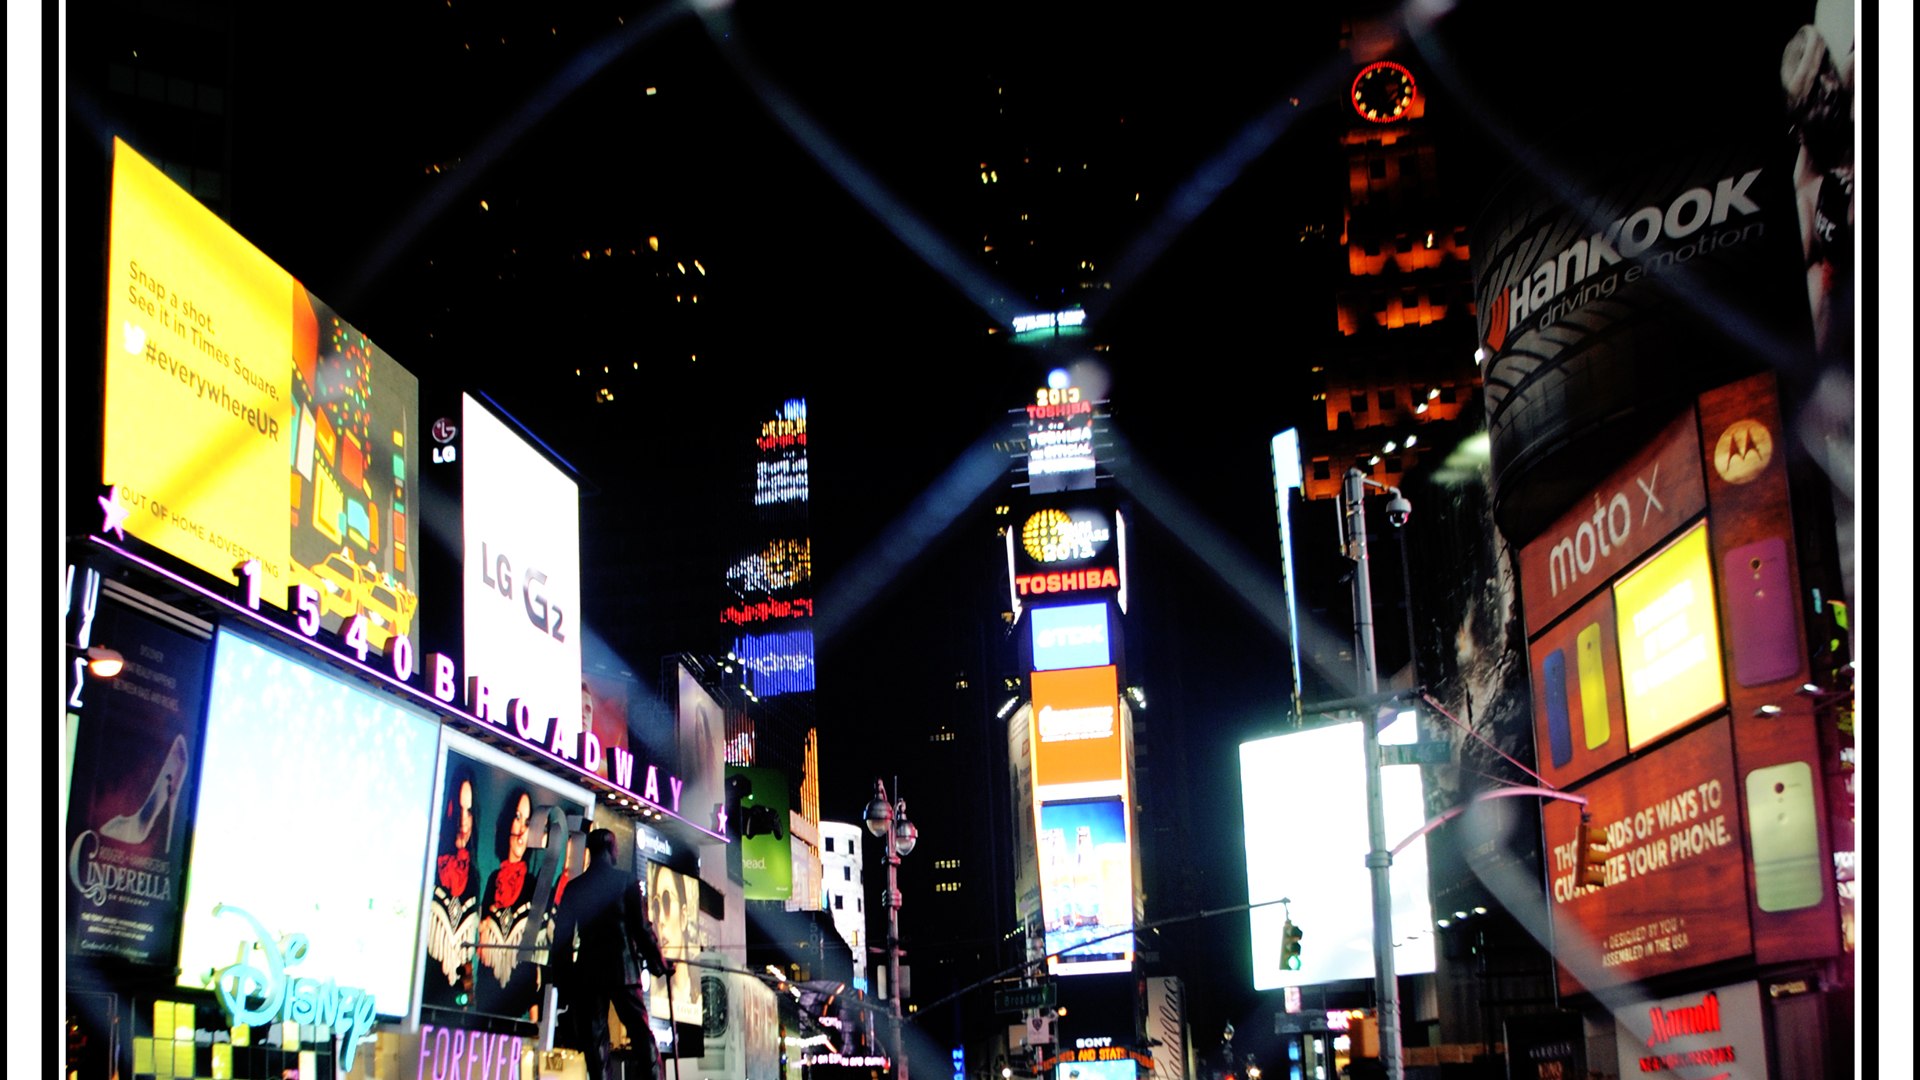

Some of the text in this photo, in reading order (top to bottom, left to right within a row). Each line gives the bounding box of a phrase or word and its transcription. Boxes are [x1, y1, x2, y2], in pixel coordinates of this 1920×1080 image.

[129, 260, 215, 335] Snap a shot.
[1539, 221, 1764, 331] driving emotion
[128, 285, 279, 402] See it in Times Square.
[145, 340, 279, 442] #everywhereUR
[1026, 400, 1091, 419] TOSHIBA
[1036, 387, 1080, 406] 2013
[433, 445, 456, 463] LG
[121, 486, 279, 578] OUT OF HOME ADVERTING
[1549, 491, 1631, 598] moto
[481, 541, 566, 643] LG G2
[1015, 568, 1119, 595] TOSHIBA
[1052, 624, 1104, 647] TDK
[432, 650, 684, 813] BROADWAY
[1554, 779, 1722, 872] THONDS OF WAYS TO
[1554, 816, 1732, 904] CUIZE YOUR PHONE.
[1602, 932, 1689, 967] ASSEMBLED IN THE USA
[1608, 917, 1678, 949] DESIGNED BY YOU
[418, 1025, 523, 1080] FOREVER
[1076, 1036, 1112, 1049] SONY
[1078, 1049, 1096, 1062] AND
